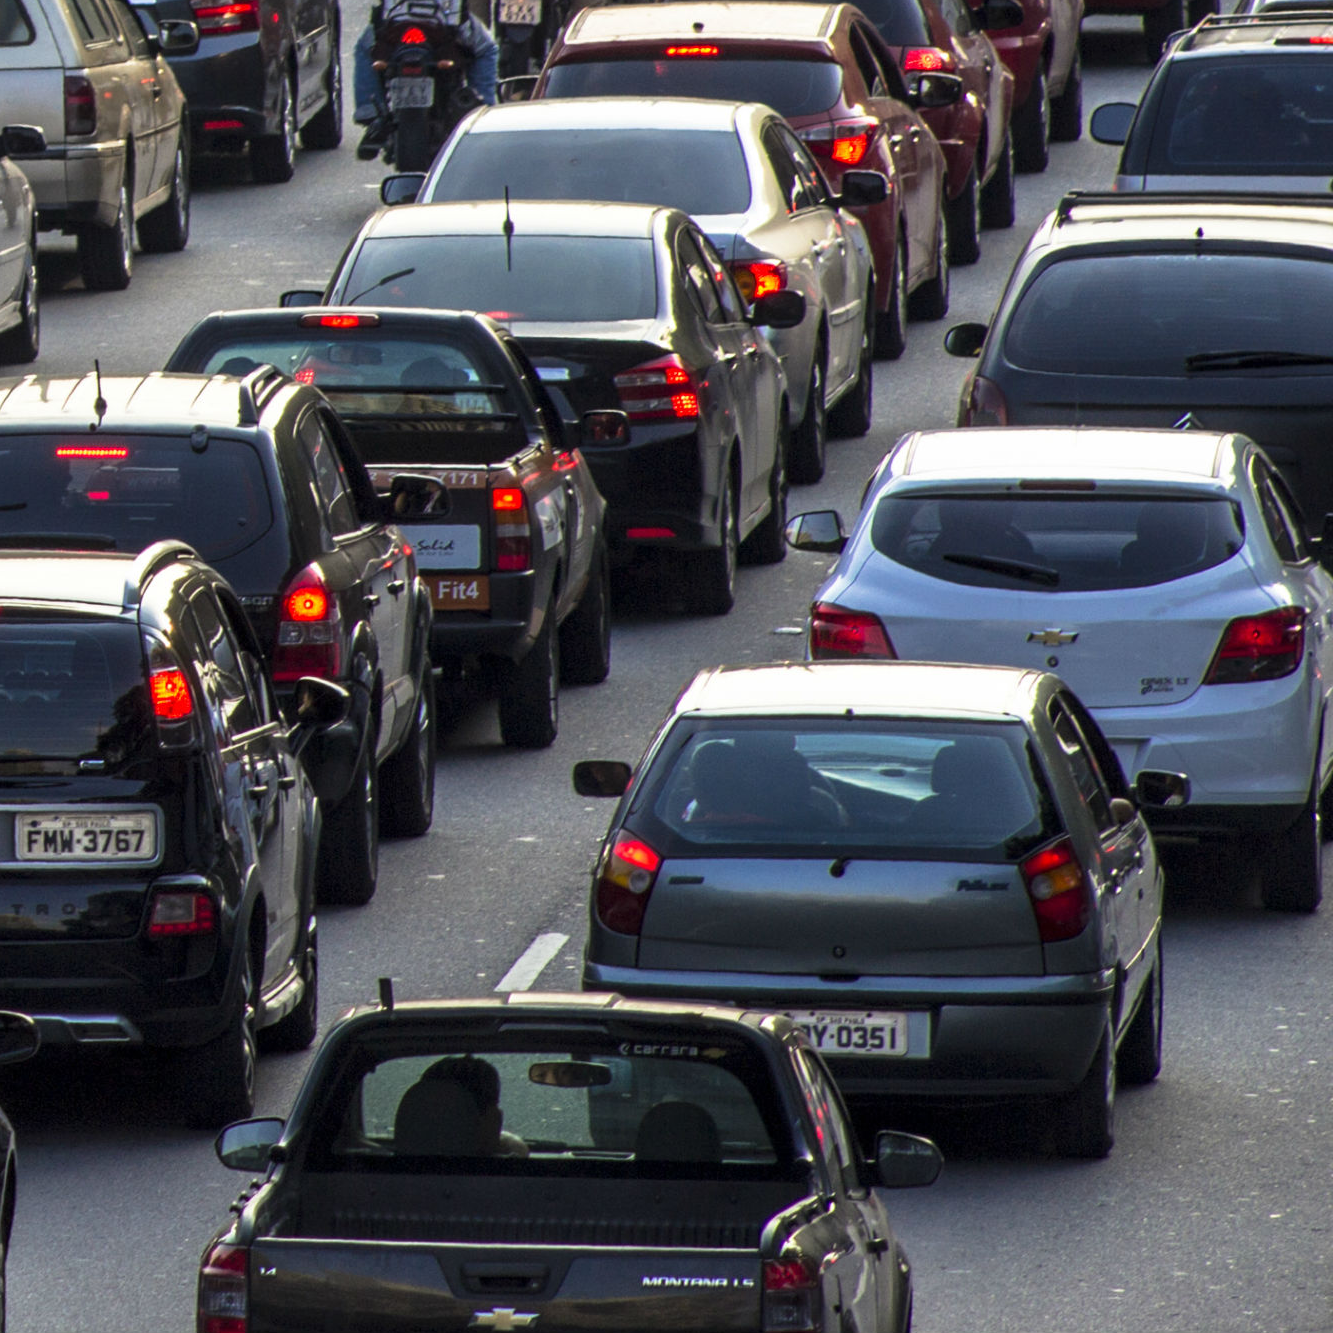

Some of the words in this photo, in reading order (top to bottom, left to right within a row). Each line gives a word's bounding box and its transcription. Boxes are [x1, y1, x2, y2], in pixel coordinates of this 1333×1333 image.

[438, 580, 480, 601] Fit4
[26, 829, 145, 854] FMW-3767
[642, 1276, 728, 1287] MONTANA
[733, 1277, 754, 1288] LS
